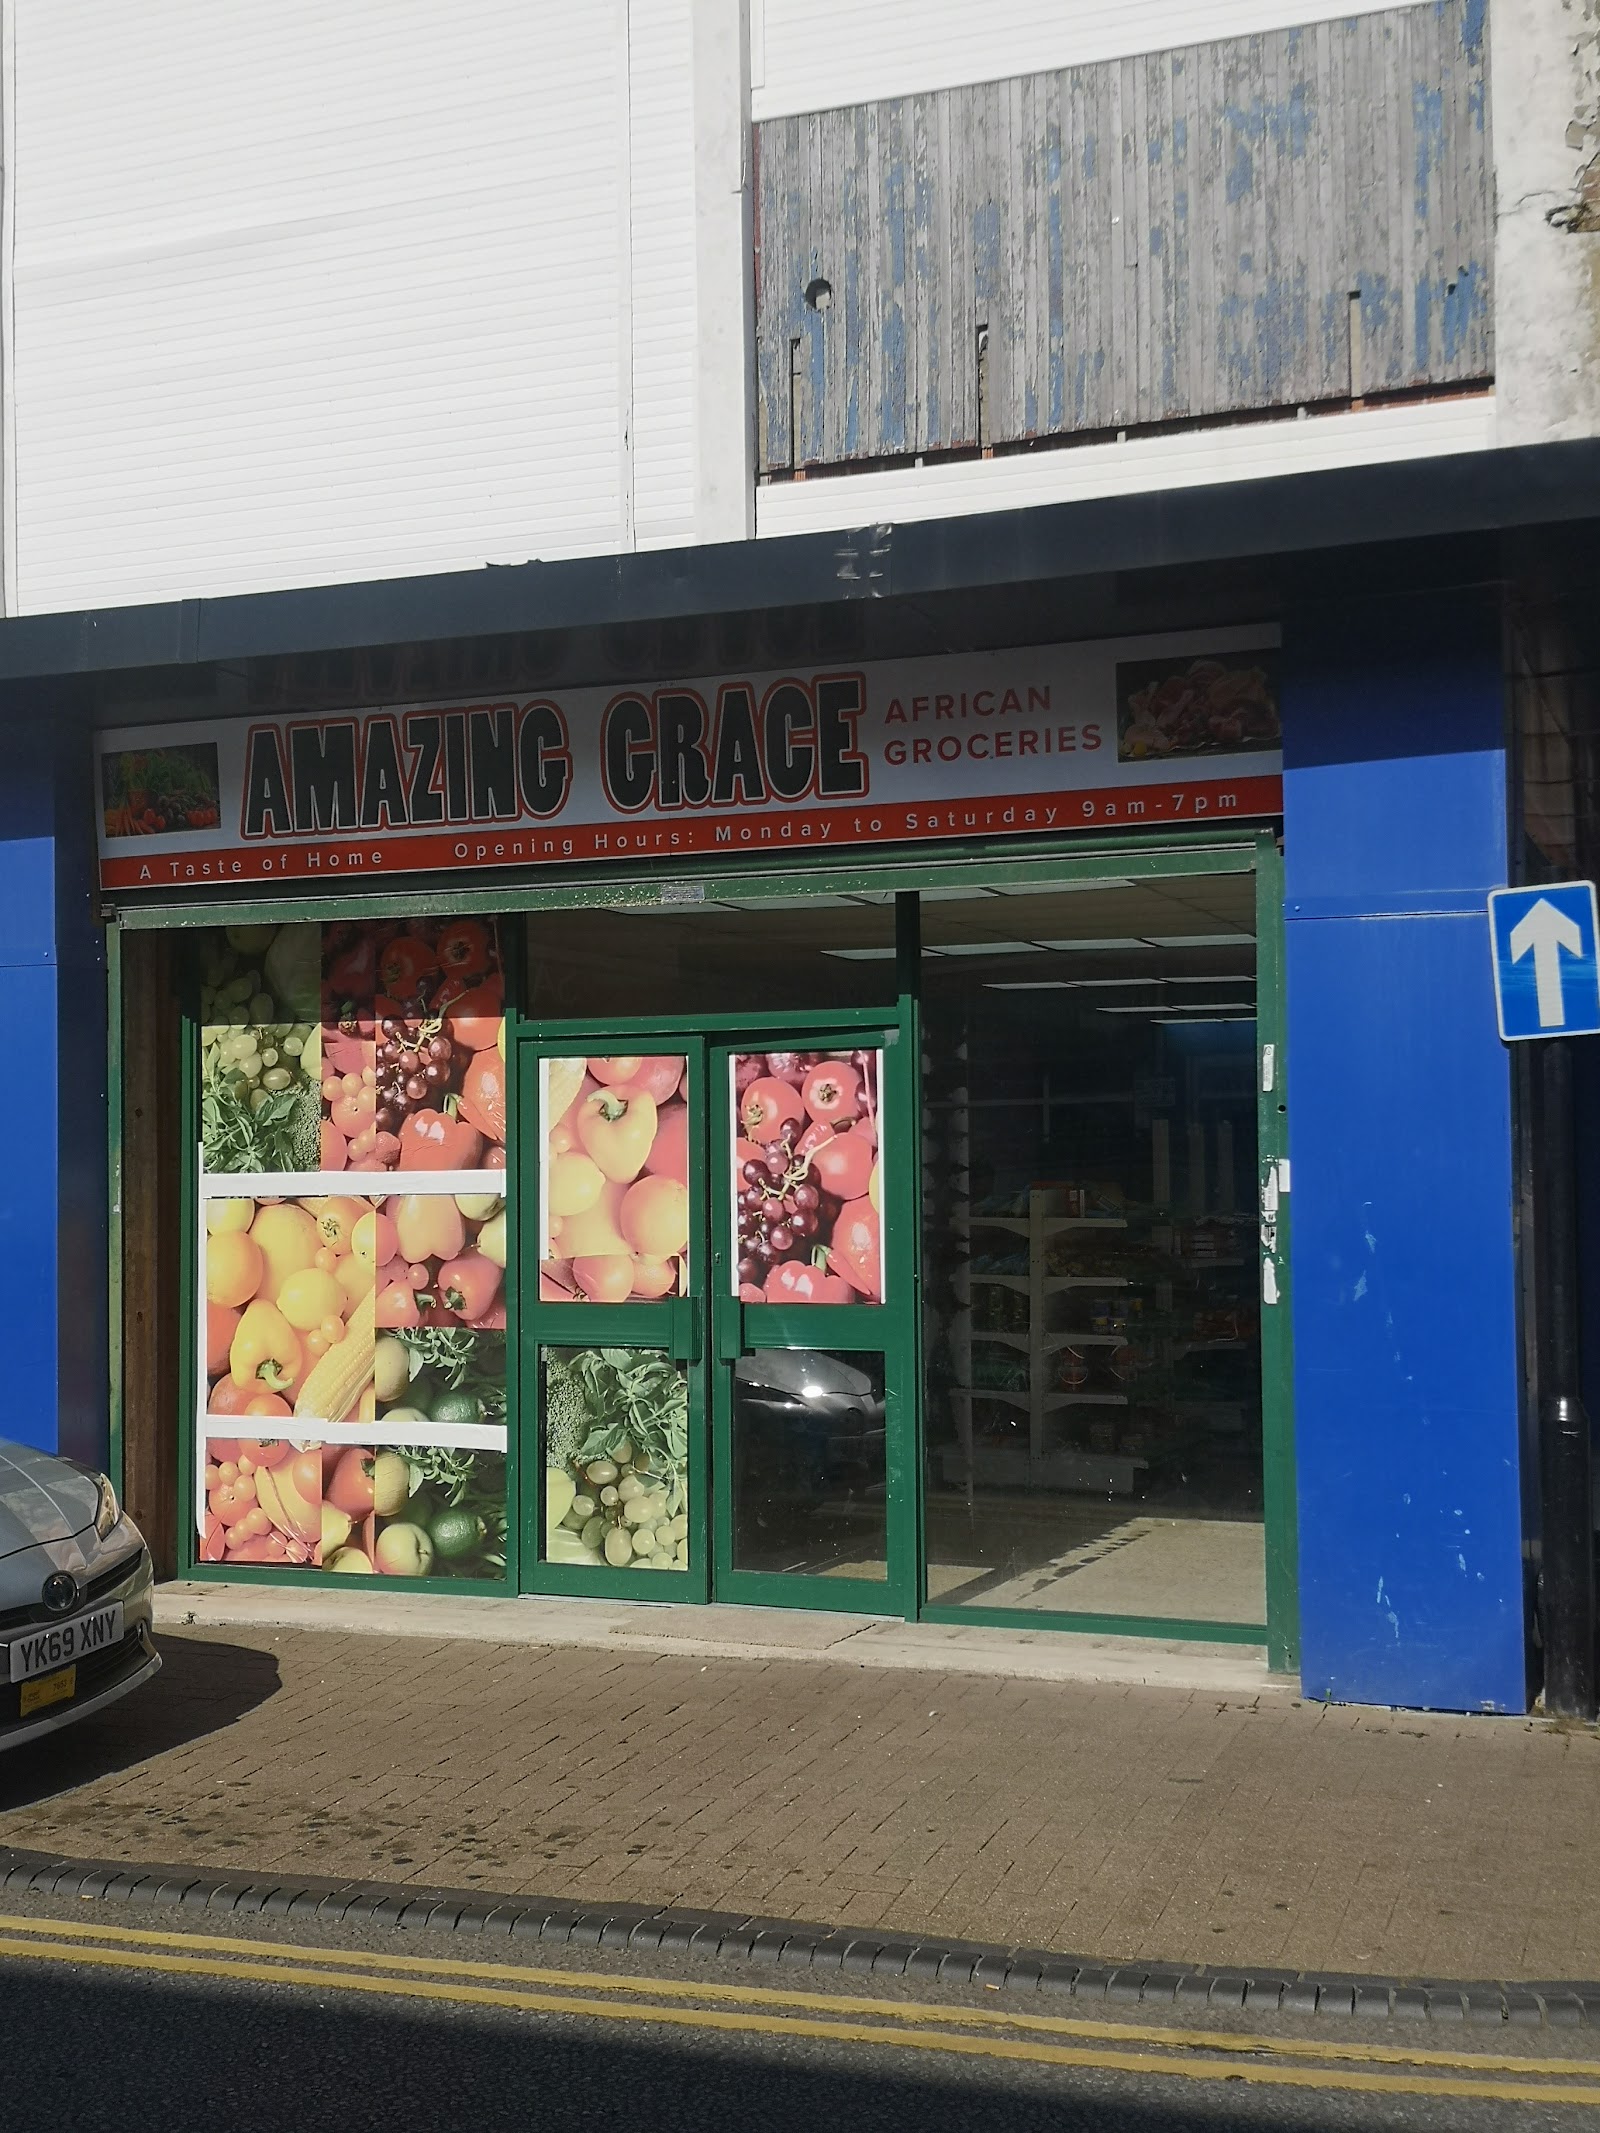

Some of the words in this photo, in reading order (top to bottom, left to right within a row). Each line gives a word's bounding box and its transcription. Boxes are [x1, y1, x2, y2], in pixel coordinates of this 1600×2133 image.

[884, 685, 1051, 725] AFRICAN
[240, 699, 573, 841] AMAZING
[600, 671, 870, 815] GRACE
[883, 724, 1102, 766] GROCERIES
[454, 838, 574, 861] Opening
[594, 831, 694, 850] Hours:
[715, 820, 832, 843] Monday
[853, 817, 883, 833] to
[905, 806, 1057, 830] Saturday
[139, 864, 152, 880] A
[170, 858, 243, 877] Taste
[262, 853, 288, 871] of
[307, 851, 383, 868] Home
[20, 1627, 75, 1672] YK69
[80, 1610, 117, 1651] XNY
